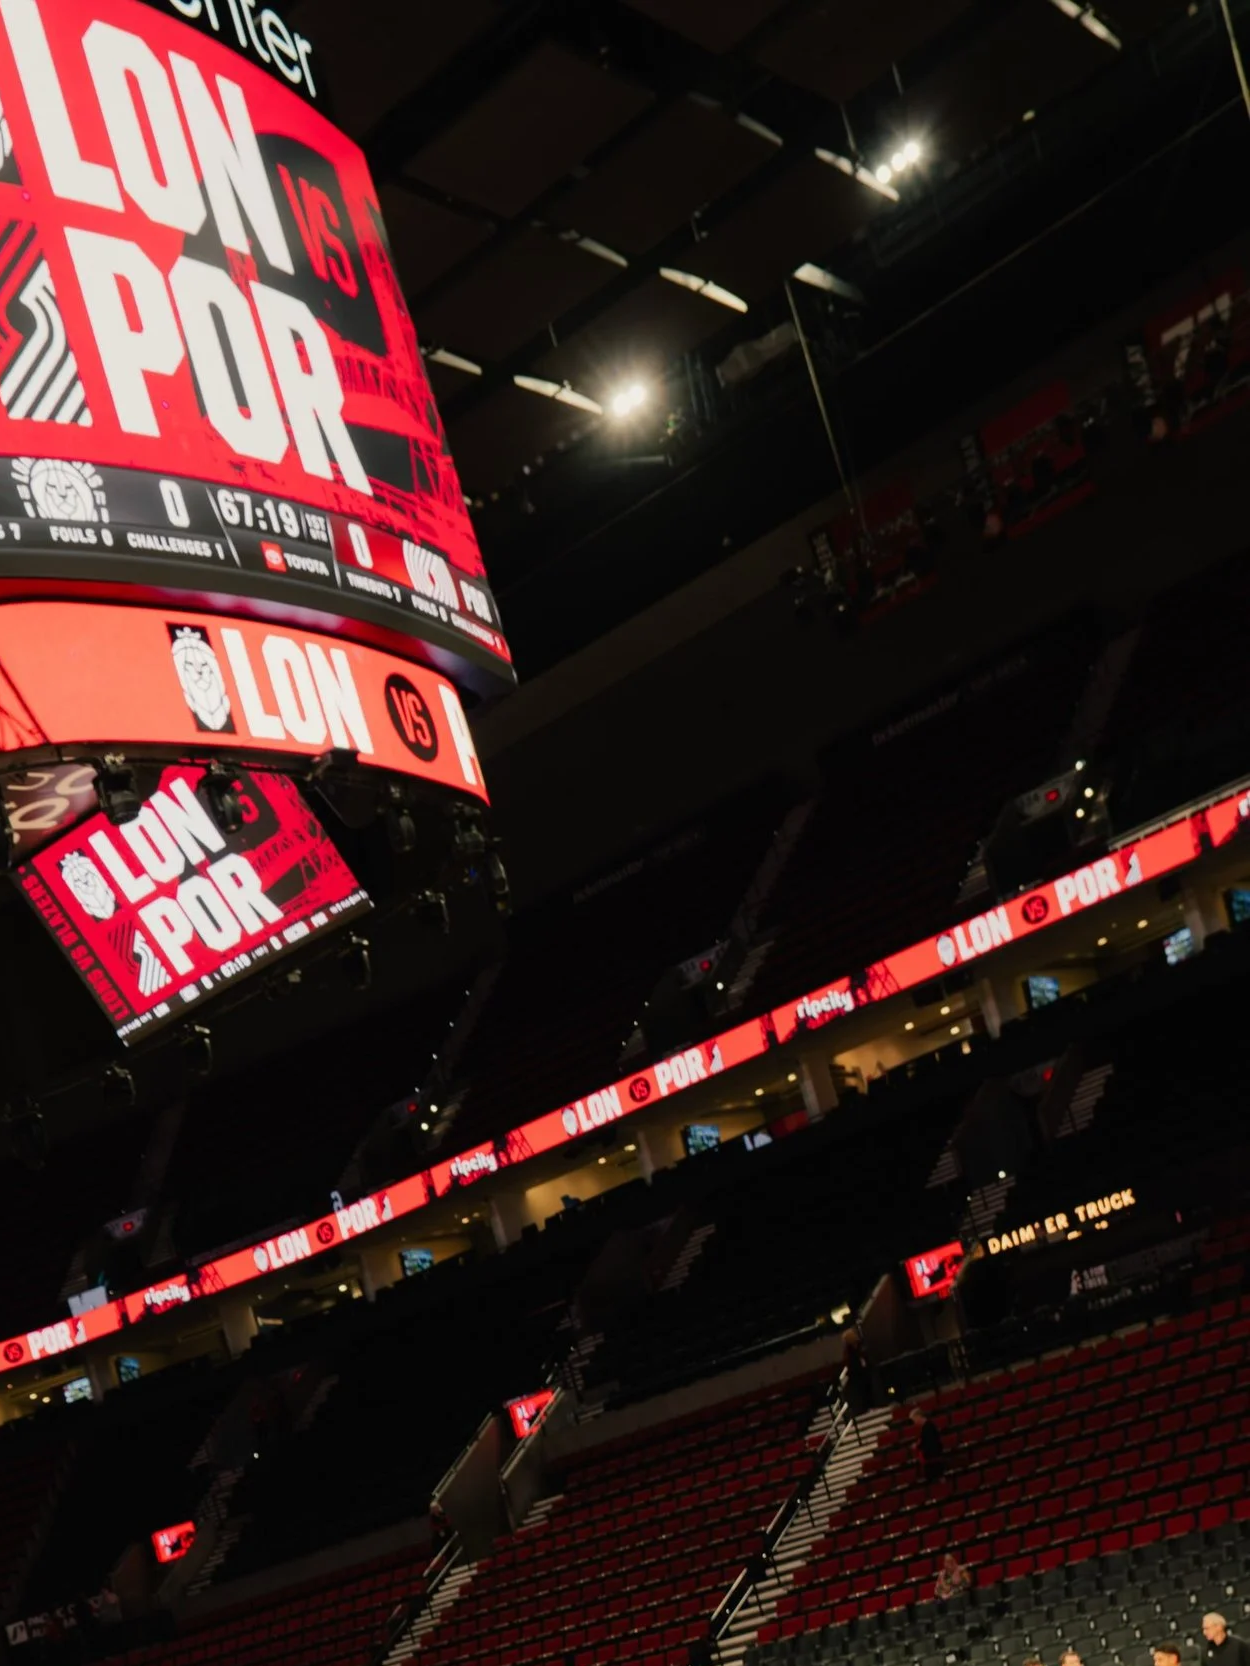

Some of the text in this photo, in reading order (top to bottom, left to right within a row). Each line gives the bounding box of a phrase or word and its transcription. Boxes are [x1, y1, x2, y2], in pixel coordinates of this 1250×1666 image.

[0, 0, 295, 276] LON
[277, 163, 359, 298] VS
[63, 226, 374, 497] POR
[9, 523, 22, 541] 7
[49, 526, 98, 545] FOULS
[127, 532, 213, 558] CHALLENGES
[215, 542, 225, 560] 1
[158, 479, 191, 529] 0
[217, 489, 301, 539] 67:19
[348, 522, 374, 570] 0
[283, 553, 330, 577] TOYOTA
[220, 626, 375, 756] LON
[389, 686, 433, 749] VS
[88, 776, 227, 904] LON
[137, 853, 285, 976] POR
[797, 990, 855, 1020] ripcity
[953, 904, 1014, 963] LON
[1053, 856, 1123, 916] POR
[576, 1084, 624, 1132] LON
[653, 1047, 708, 1097] POR
[265, 1228, 312, 1270] LON
[334, 1199, 382, 1240] POR
[987, 1212, 1070, 1256] DAIMER
[1074, 1187, 1136, 1224] TRUCK
[26, 1322, 76, 1361] POR
